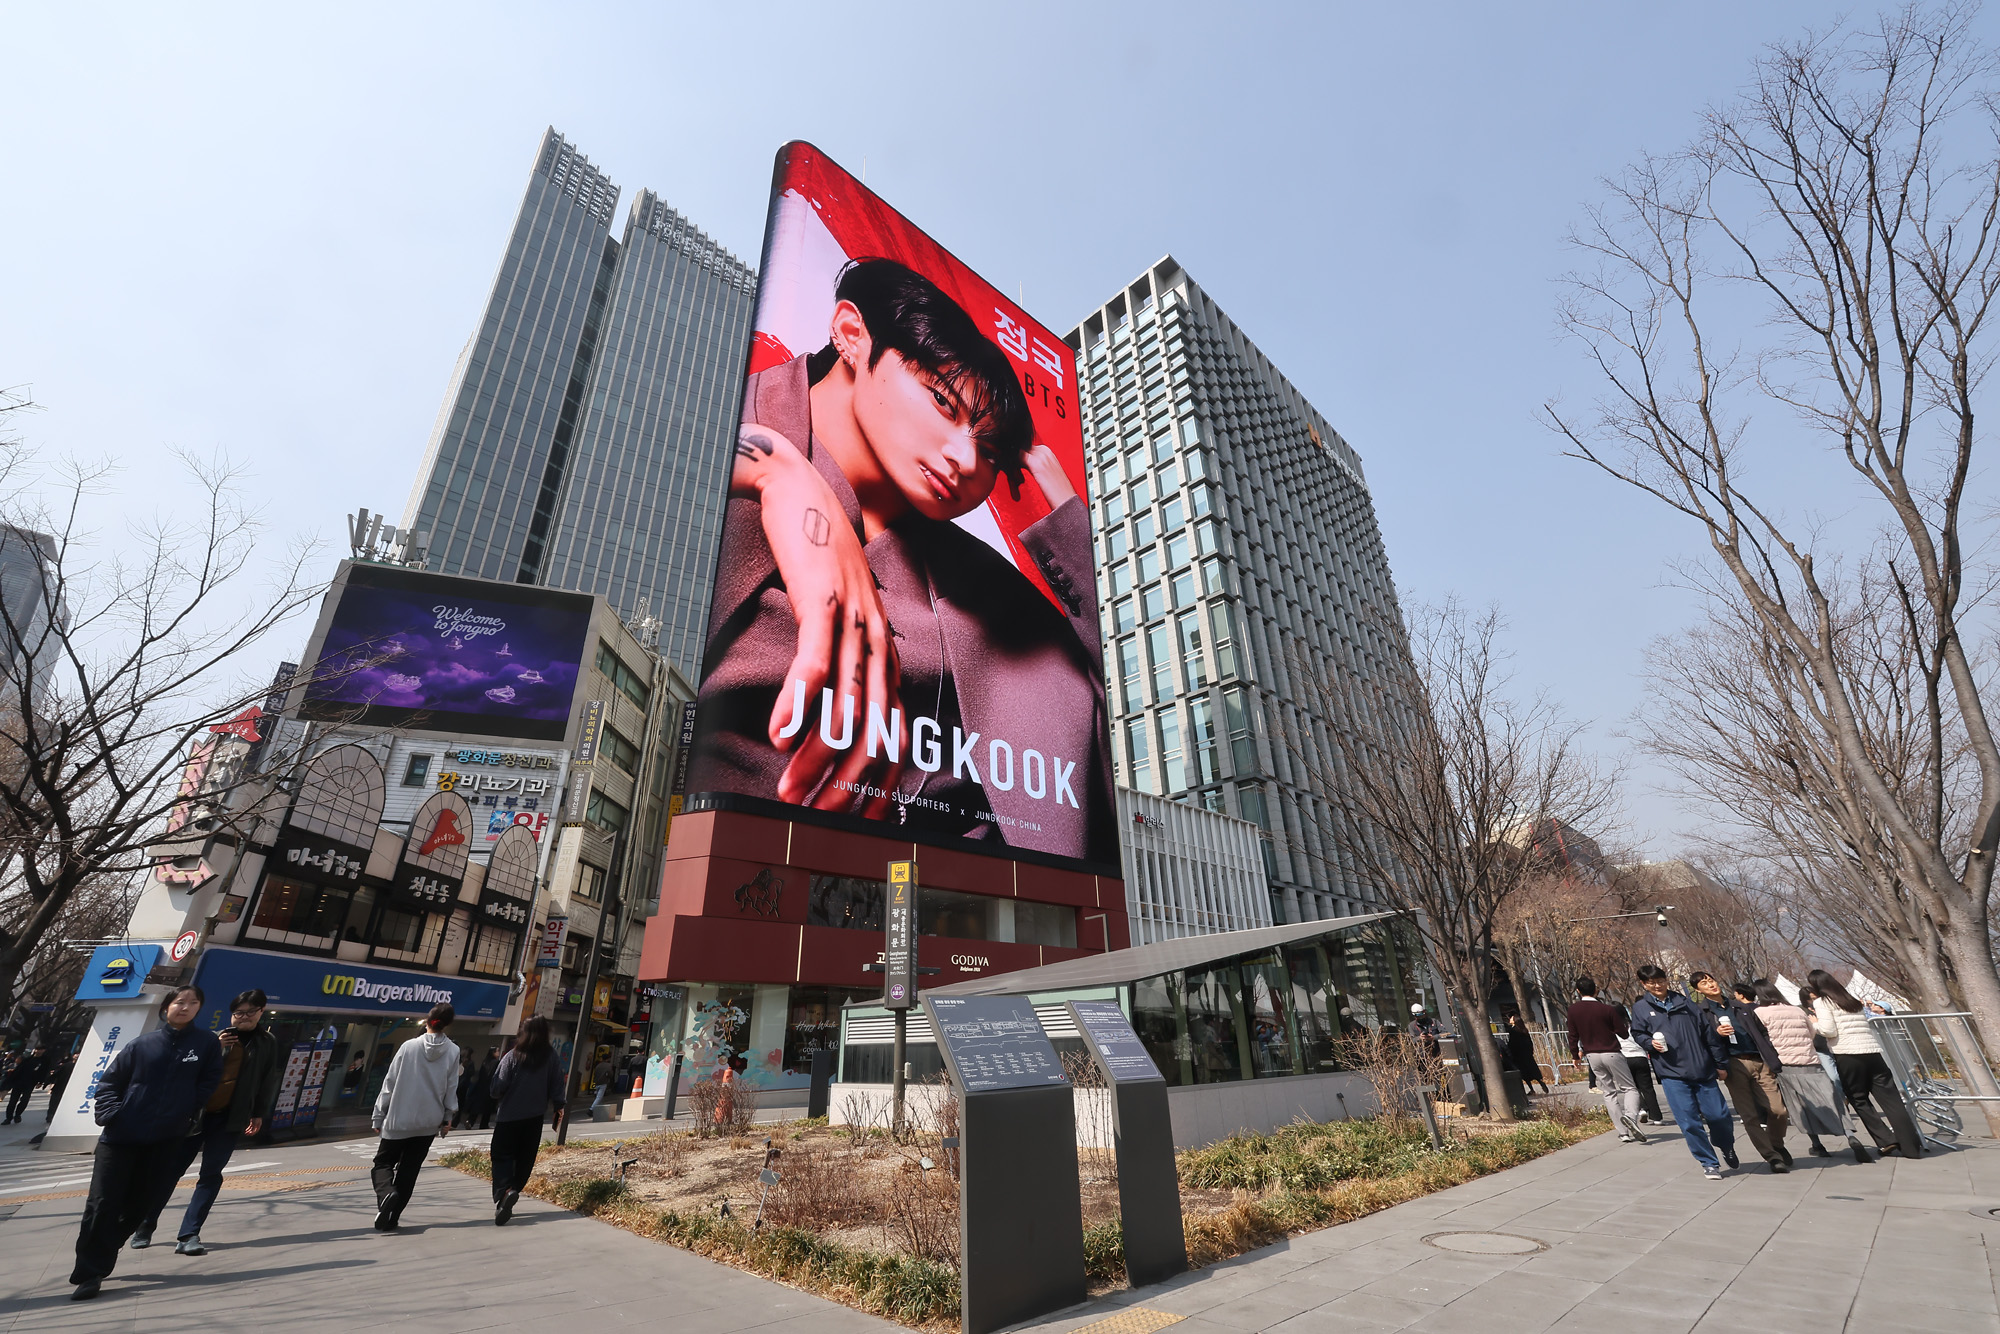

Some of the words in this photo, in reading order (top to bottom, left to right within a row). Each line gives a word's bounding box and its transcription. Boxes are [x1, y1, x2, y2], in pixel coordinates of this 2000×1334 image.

[994, 307, 1064, 390] 정국
[1025, 371, 1066, 419] BTS
[432, 605, 506, 630] Welcome
[434, 619, 448, 629] to
[441, 620, 498, 640] Jongno
[779, 679, 1080, 809] JUNGKOOK
[436, 771, 551, 797] 강비뇨기과
[483, 794, 539, 811] 피부과
[833, 779, 887, 799] JUNGKOOK
[891, 791, 951, 813] SUPPORTERS
[974, 809, 1016, 827] JUNGKOOK
[1019, 820, 1042, 832] CHINA
[286, 847, 362, 880] 마녀김밥
[408, 876, 450, 904] 청담동
[895, 885, 904, 897] 7
[485, 902, 526, 924] 마녀김밥
[543, 921, 564, 958] 약국
[891, 908, 900, 948] 광화문
[177, 939, 191, 954] 30
[951, 954, 989, 967] GODIVA
